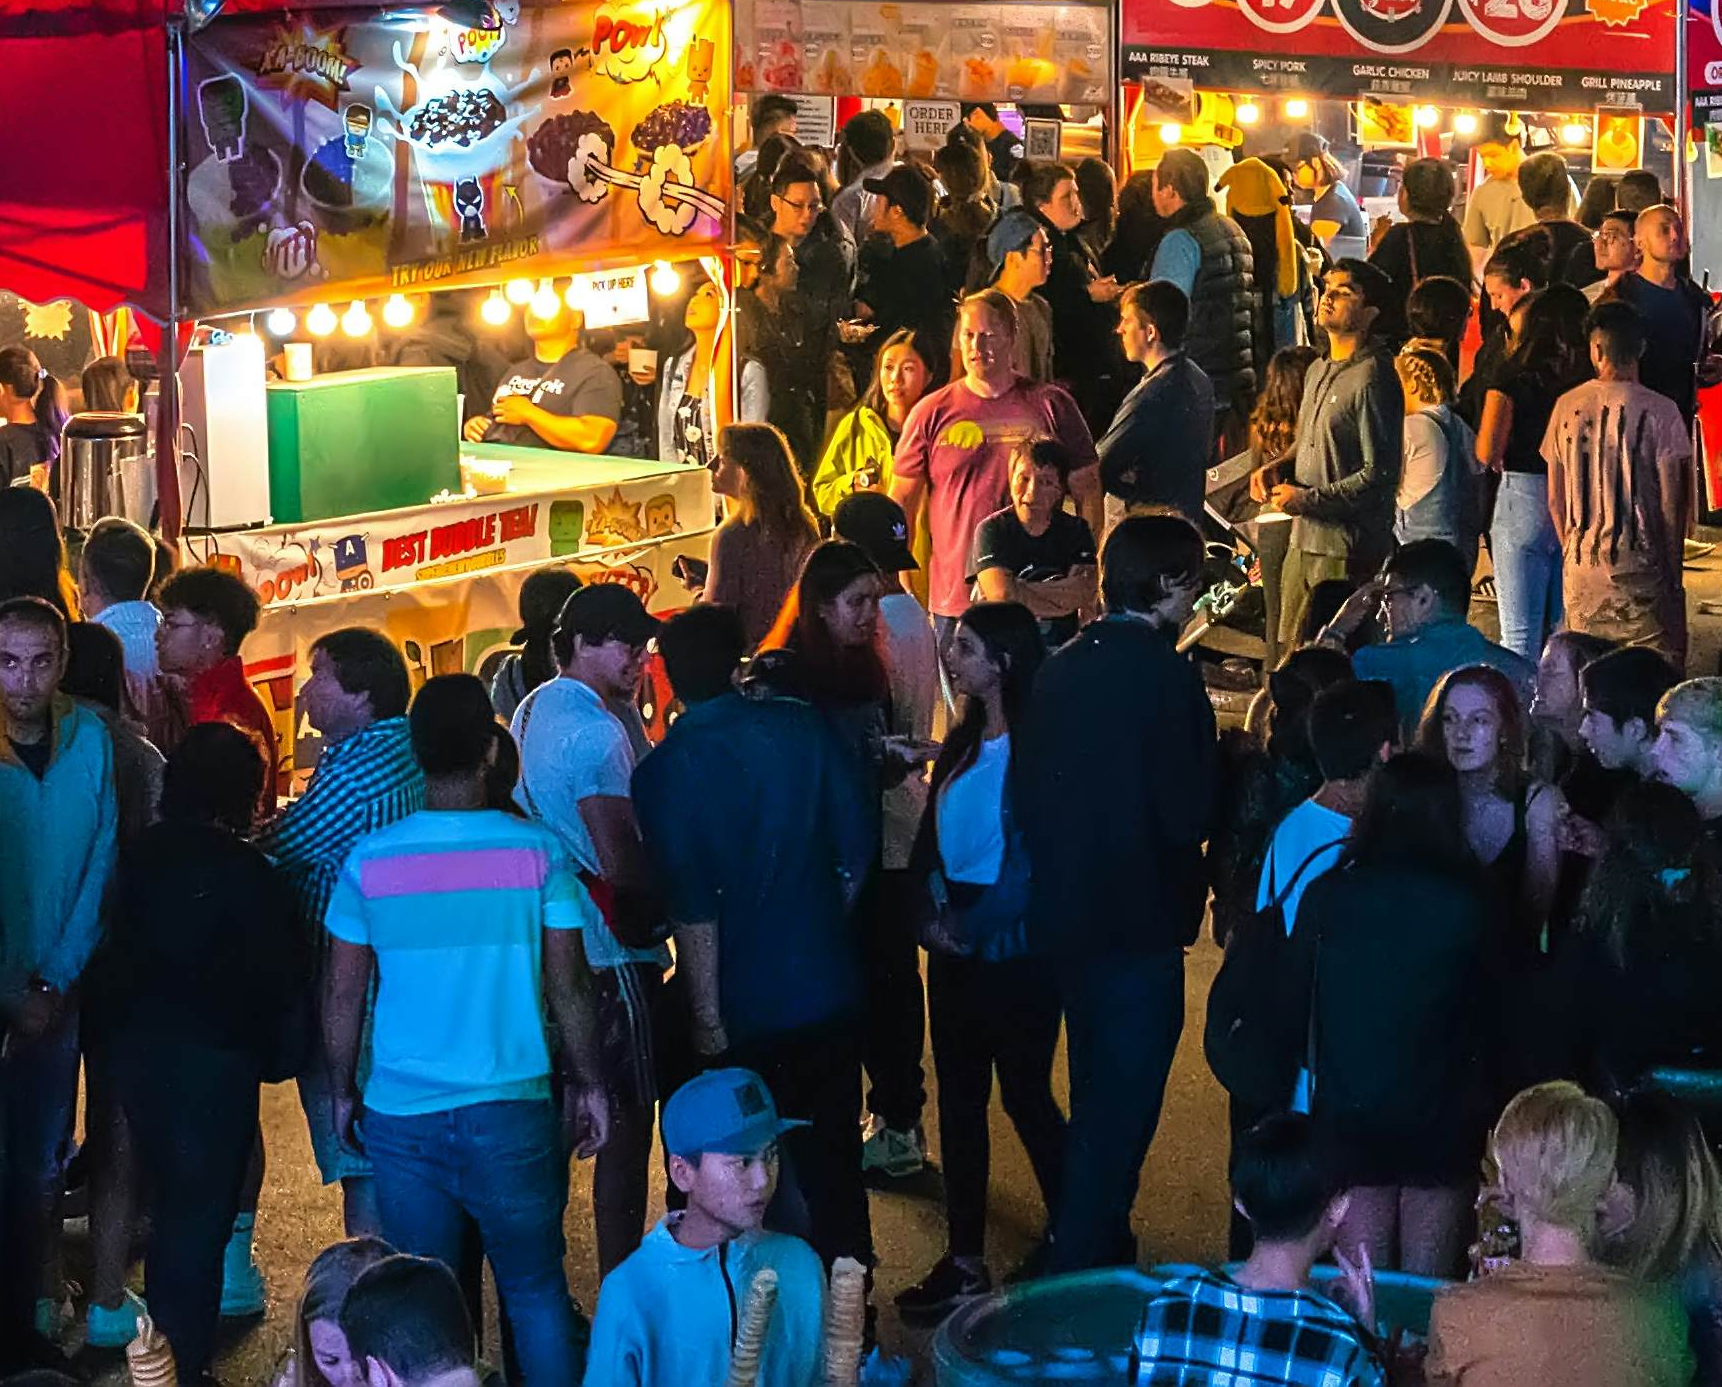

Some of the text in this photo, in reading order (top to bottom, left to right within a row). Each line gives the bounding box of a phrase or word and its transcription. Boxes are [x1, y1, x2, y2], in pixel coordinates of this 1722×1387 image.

[1128, 52, 1148, 63] AAA
[1182, 54, 1210, 67] STEAK
[1252, 58, 1278, 71] SPICY
[1353, 64, 1430, 79] GARLIC CHICKEN
[1452, 69, 1479, 83] JUICY
[1509, 72, 1563, 87] SHOULDER
[1581, 76, 1662, 92] GRILL PINEAPPLE
[909, 106, 955, 122] ORDER
[380, 530, 428, 573] BEST
